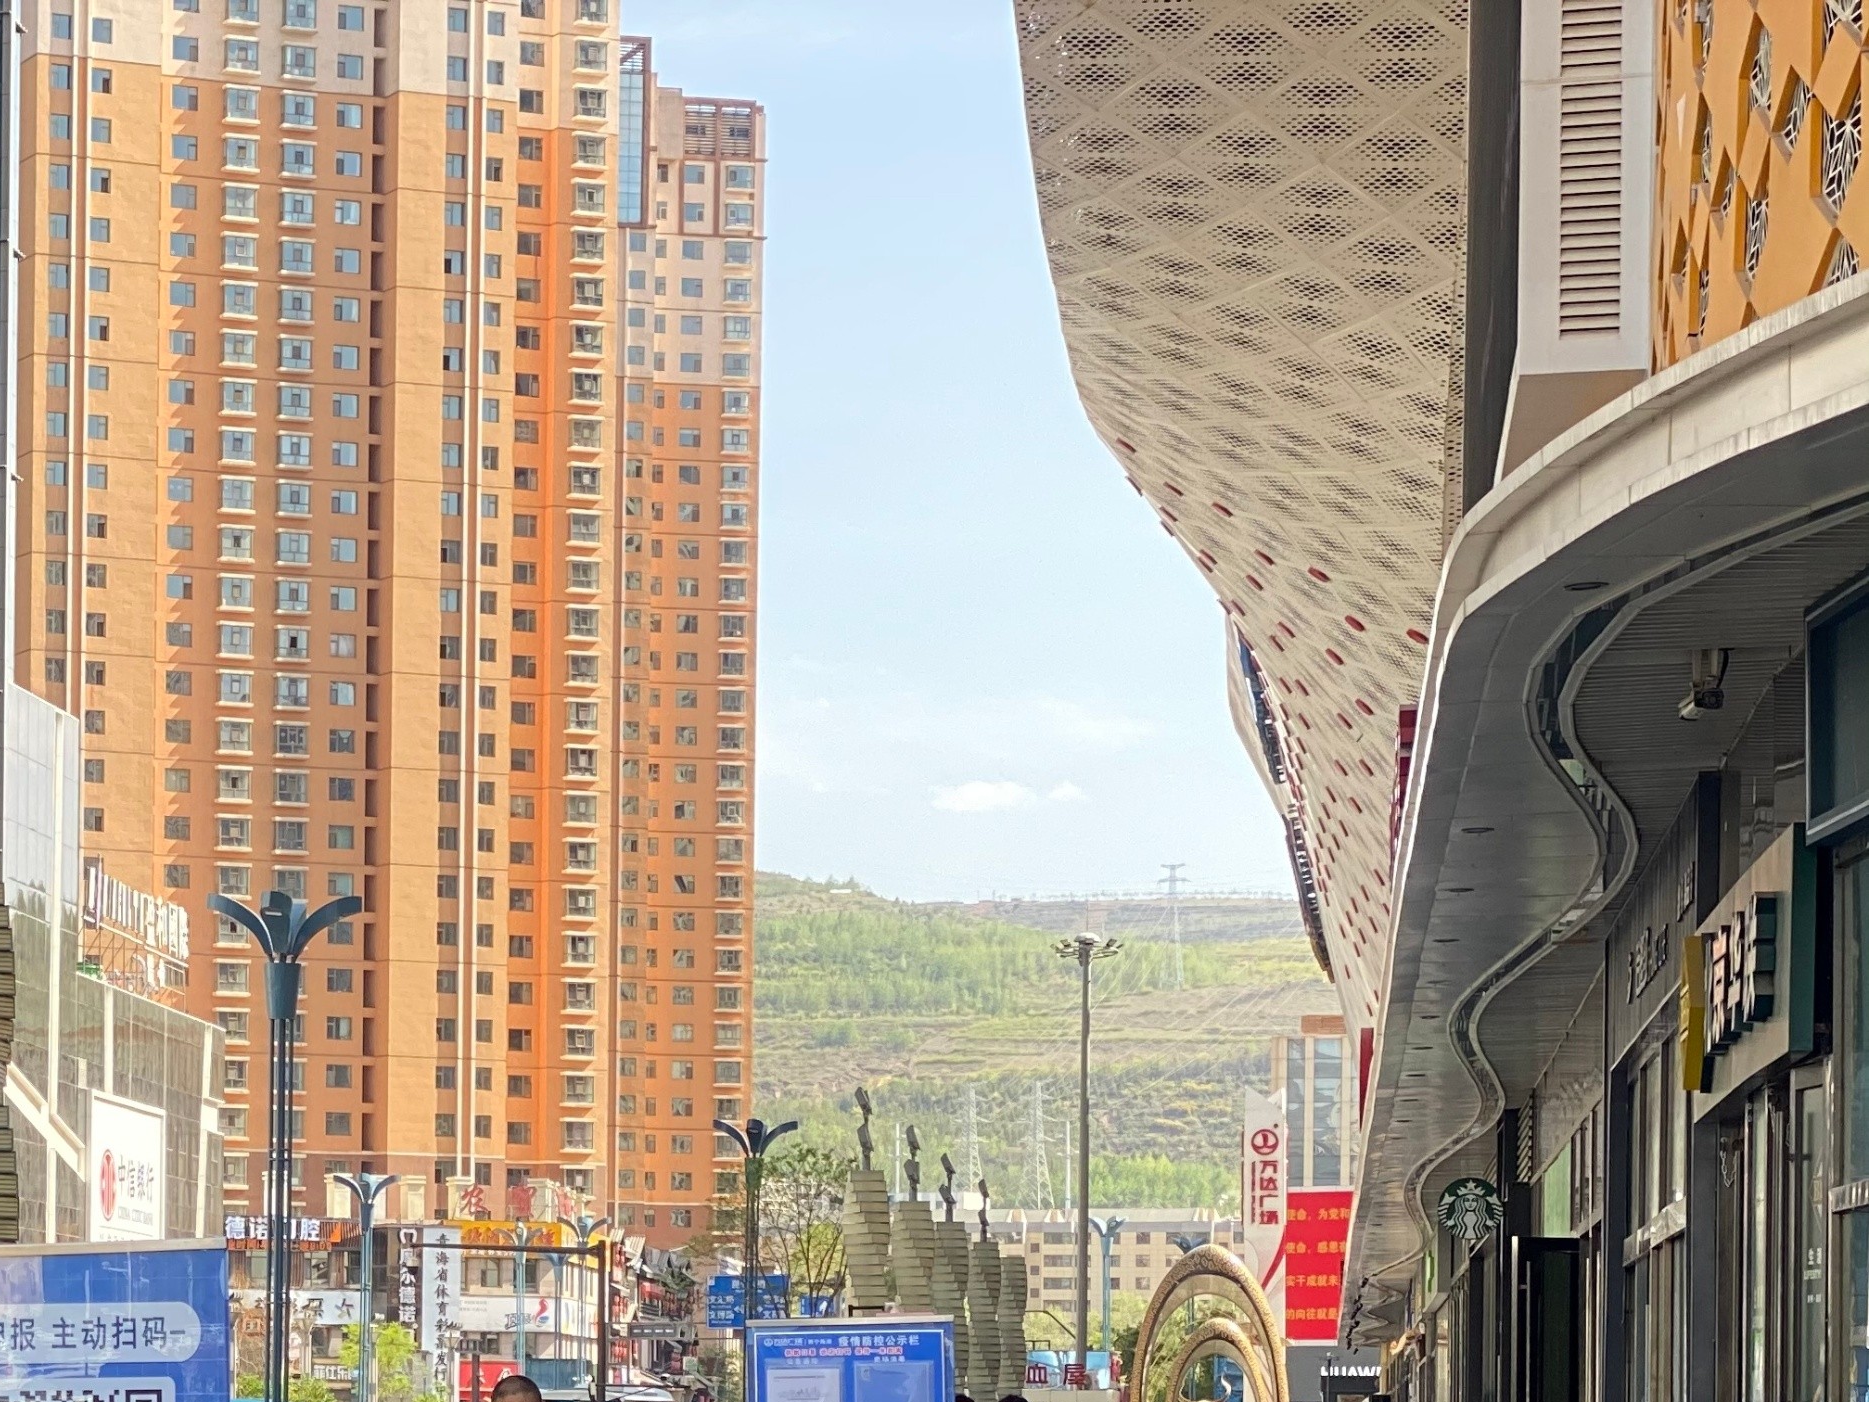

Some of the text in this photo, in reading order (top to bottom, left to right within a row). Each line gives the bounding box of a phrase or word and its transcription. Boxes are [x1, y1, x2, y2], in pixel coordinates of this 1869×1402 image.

[118, 1154, 154, 1203] 中信银行
[1259, 1160, 1279, 1225] 万达广场
[51, 1317, 170, 1351] 主动扫码
[838, 1335, 920, 1347] 疫情防控公示栏
